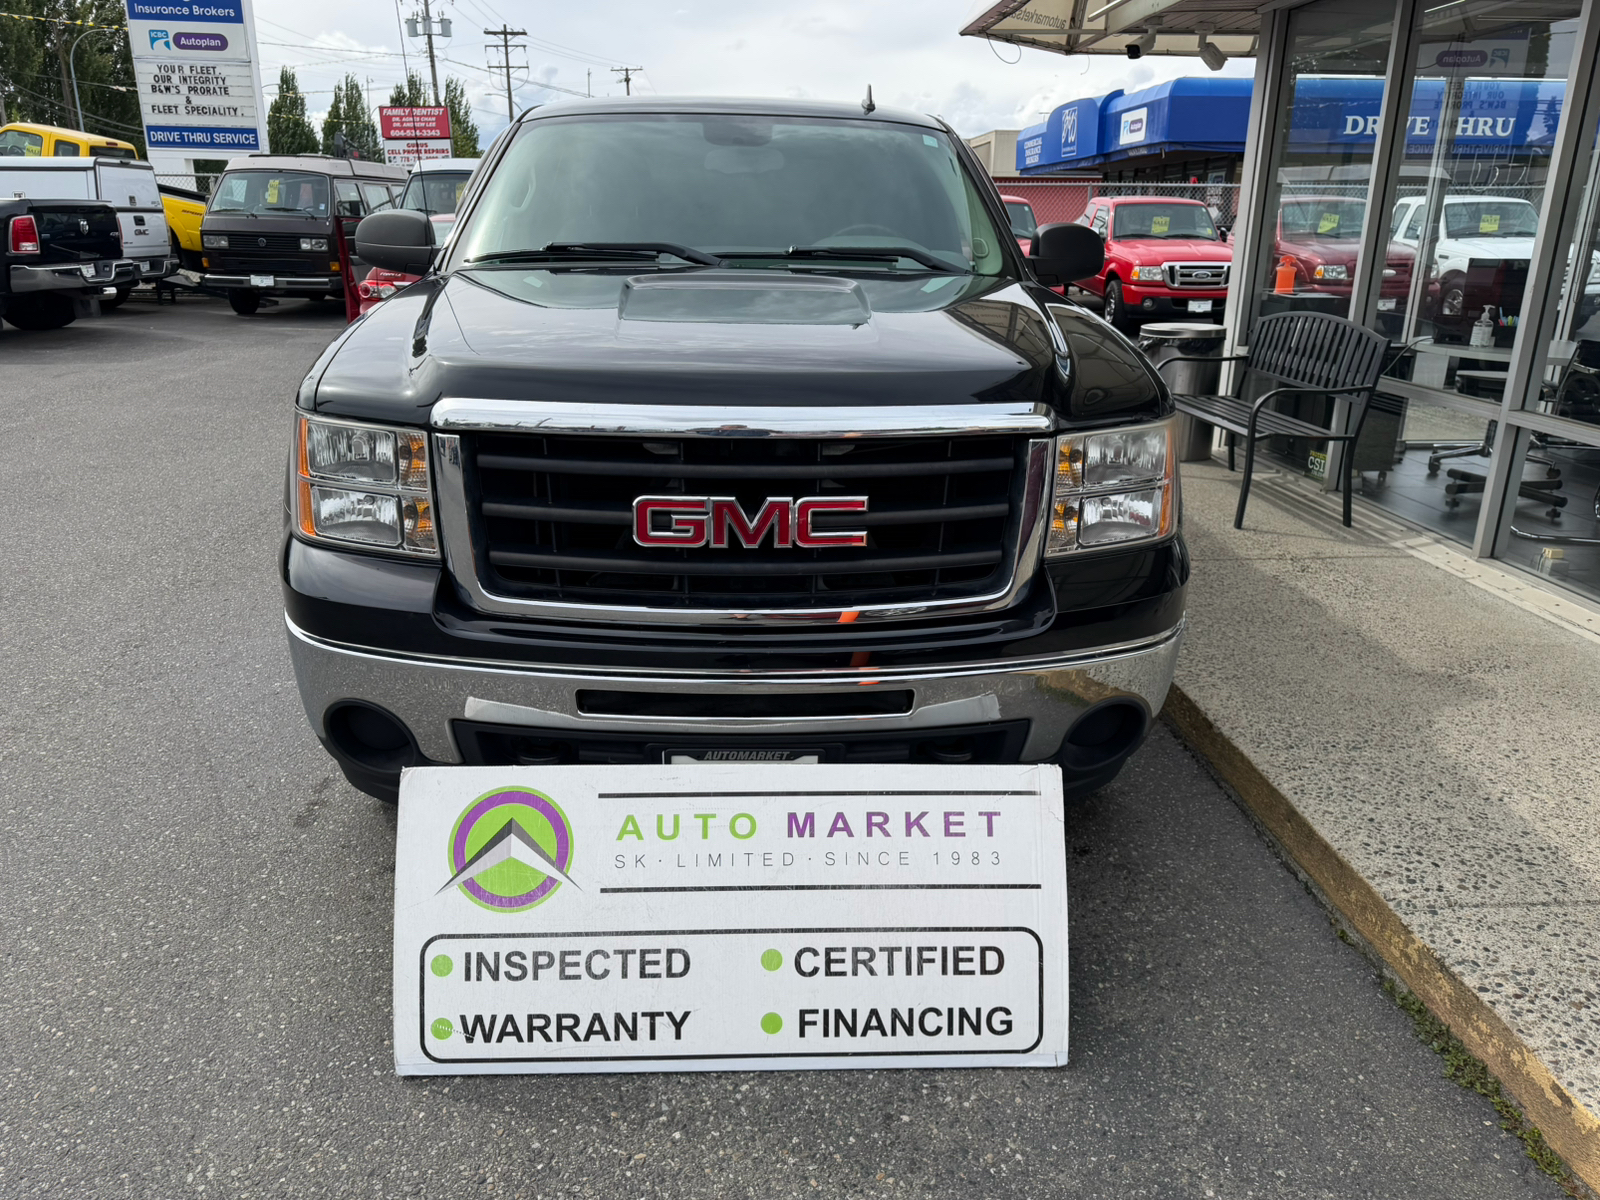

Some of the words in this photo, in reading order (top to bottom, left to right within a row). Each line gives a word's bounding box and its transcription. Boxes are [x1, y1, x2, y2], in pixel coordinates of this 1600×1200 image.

[134, 3, 190, 15] Insurance
[193, 5, 235, 17] Brokers
[180, 37, 221, 47] Autoplan
[157, 64, 184, 74] YOUR
[189, 66, 222, 75] FLEET.
[153, 75, 172, 84] OUR
[179, 76, 226, 85] INTEGRITY
[151, 85, 181, 94] B&W'S
[188, 86, 229, 95] PRORATE
[185, 96, 192, 105] &
[151, 105, 178, 114] FLEET
[383, 108, 410, 116] FAMILY
[412, 108, 444, 116] DENTIST
[1455, 117, 1516, 137] HRU
[150, 131, 181, 142] DRIVE
[182, 132, 211, 143] THRU
[213, 133, 256, 145] SERVICE
[1308, 456, 1325, 472] CSI
[632, 495, 869, 548] GMC
[704, 751, 790, 760] AUTOMARKET
[616, 812, 757, 841] AUTO
[787, 811, 1002, 838] MARKET
[933, 851, 1001, 866] 1983
[464, 948, 691, 982] INSPECTED
[794, 946, 1005, 978] CERTIFIED
[459, 1011, 692, 1044] WARRANTY
[799, 1007, 1013, 1038] FINANCING
